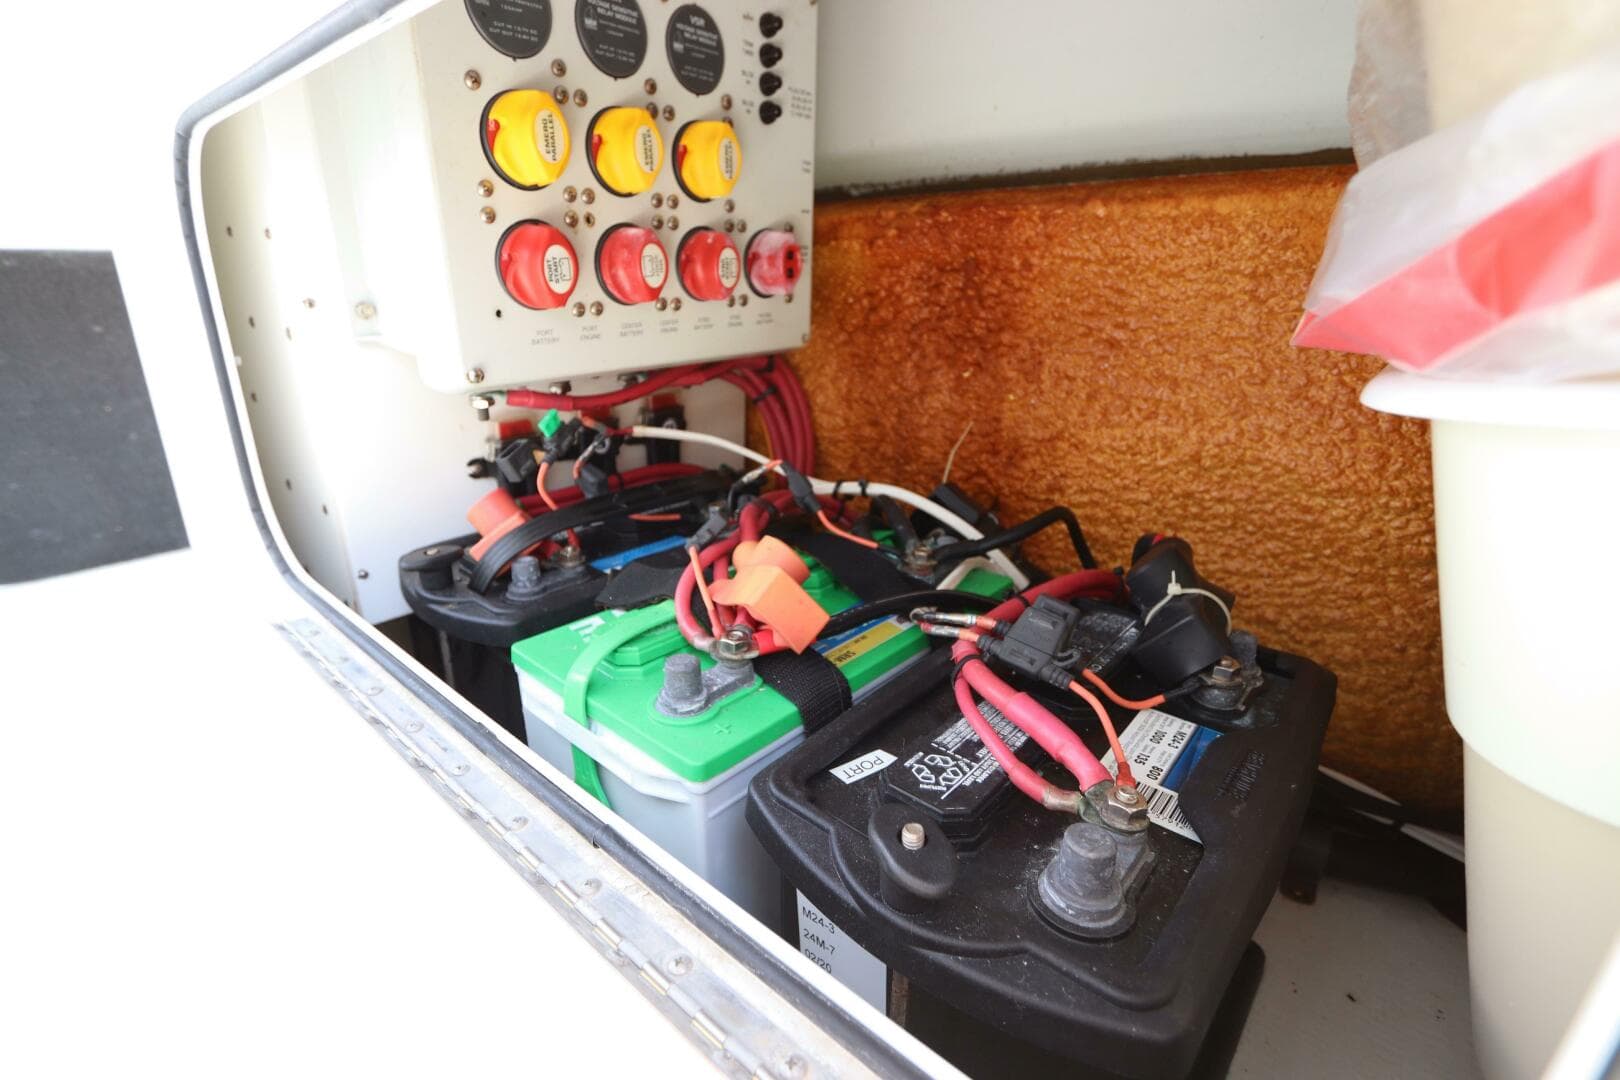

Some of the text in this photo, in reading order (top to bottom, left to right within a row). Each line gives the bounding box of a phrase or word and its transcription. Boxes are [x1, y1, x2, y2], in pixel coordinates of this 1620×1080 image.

[552, 256, 560, 284] START
[531, 337, 560, 346] BATTERY
[1167, 730, 1188, 750] M24-3
[842, 755, 885, 780] PORT
[1134, 751, 1151, 766] 135
[1146, 765, 1164, 781] 800
[802, 906, 835, 935] M24-3
[803, 928, 836, 956] 24M-7
